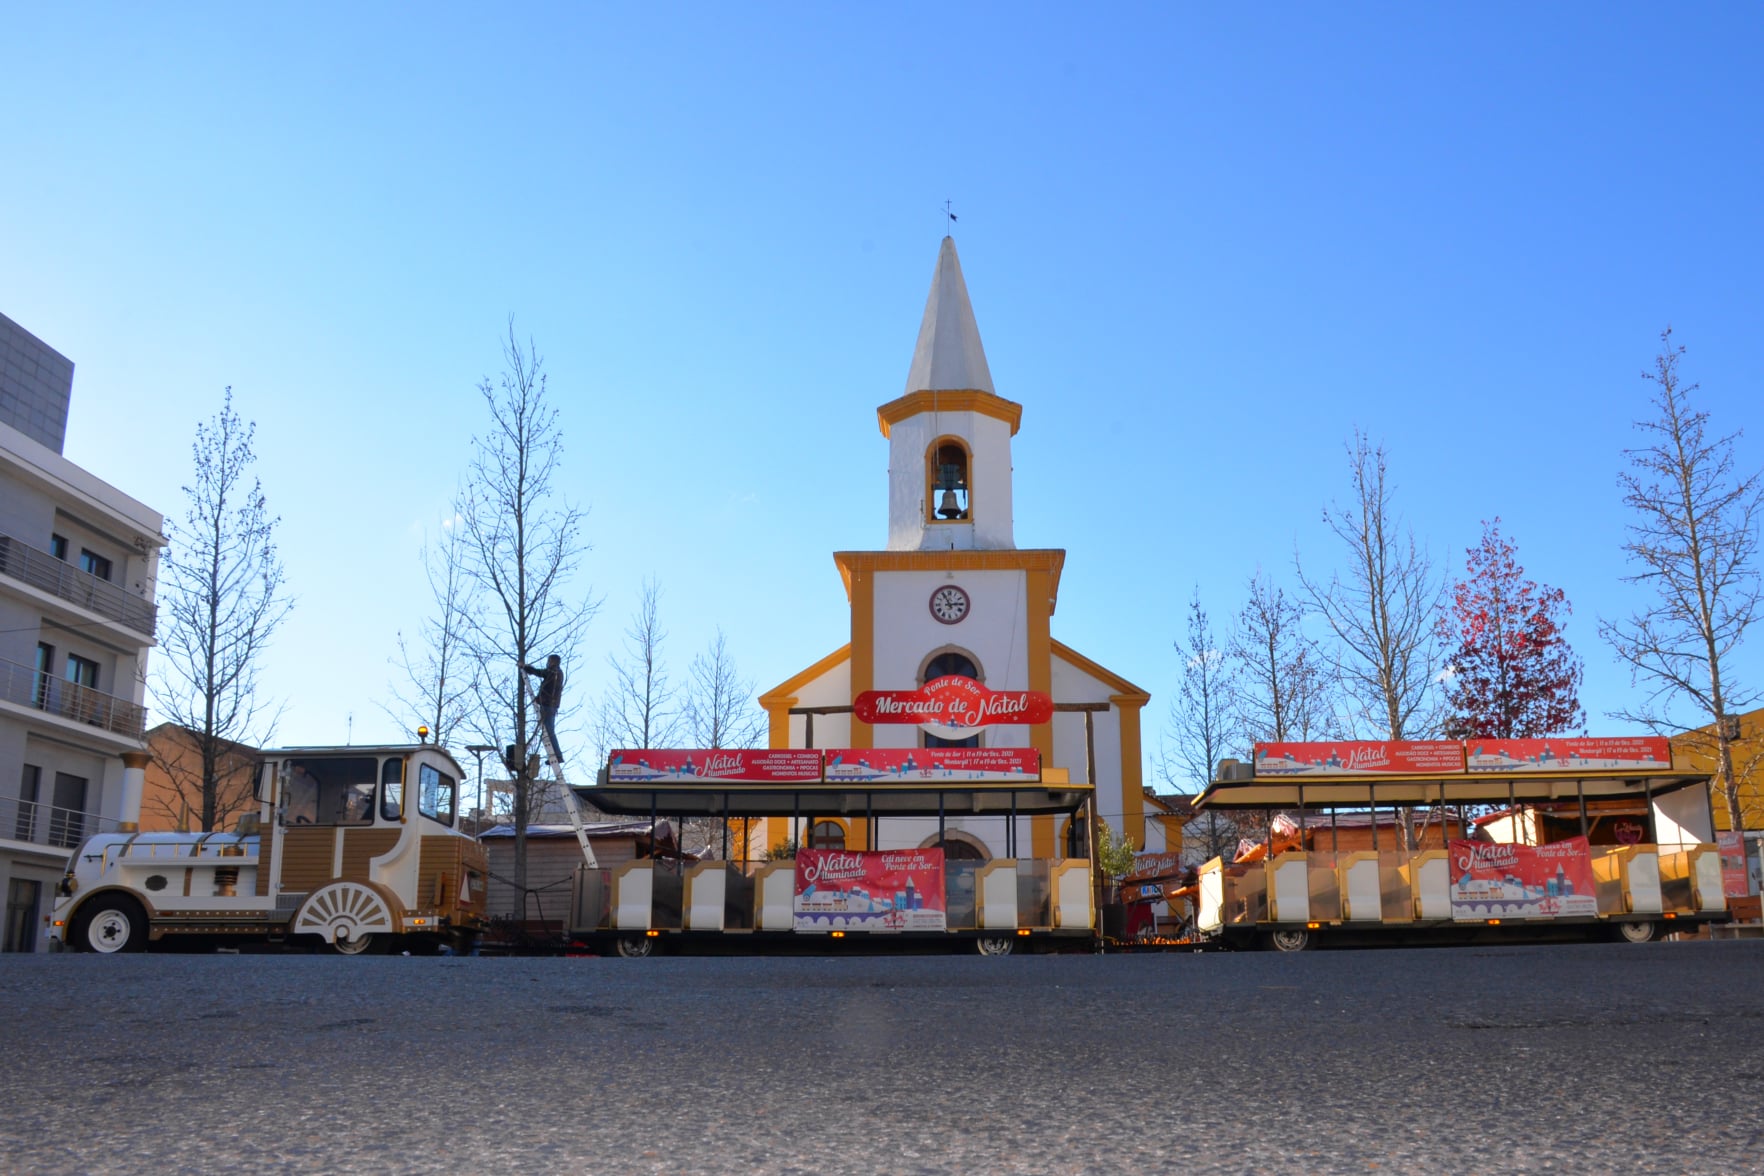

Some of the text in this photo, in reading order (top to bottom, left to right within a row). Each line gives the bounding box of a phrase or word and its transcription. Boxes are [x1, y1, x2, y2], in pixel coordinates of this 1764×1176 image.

[924, 677, 981, 698] Ponte de Sor
[875, 693, 1029, 727] Mercado de Natal
[694, 752, 744, 778] Natal
[1340, 745, 1388, 770] Natal
[1458, 844, 1516, 871] Natal
[1474, 856, 1519, 870] Iluminado
[1536, 849, 1556, 857] Ponte
[1557, 849, 1566, 857] de
[804, 852, 865, 882] Natal
[822, 868, 866, 881] Iluminado
